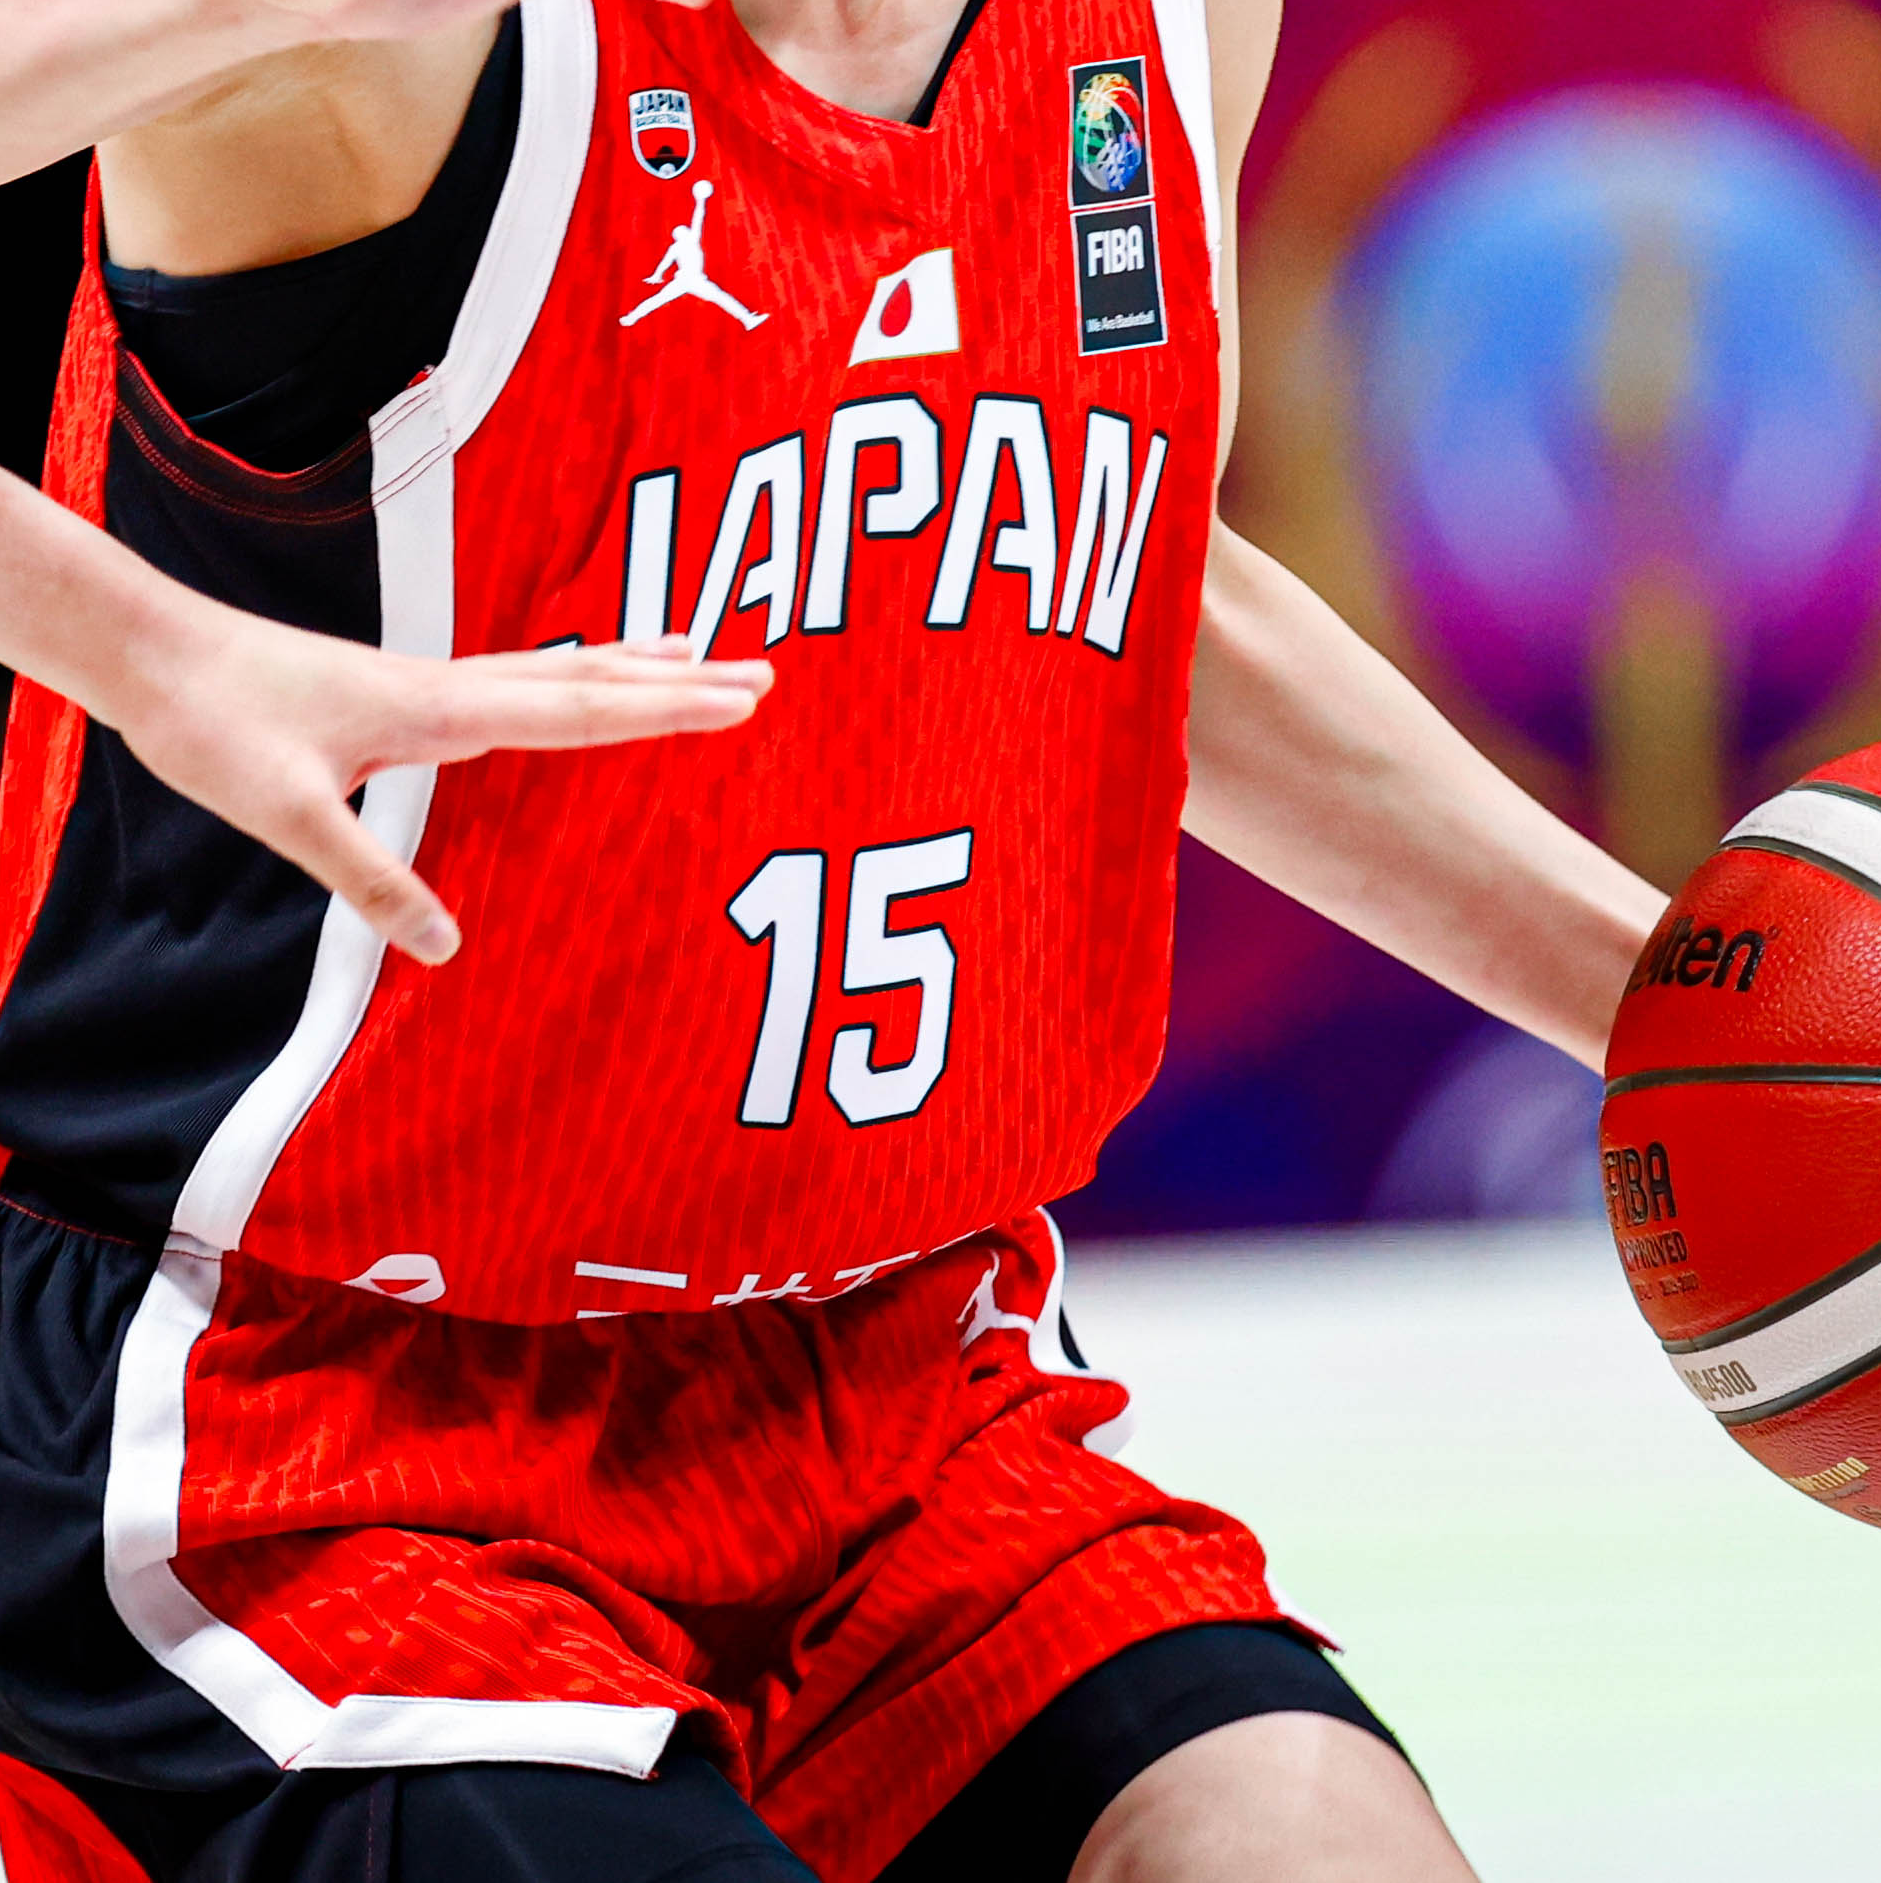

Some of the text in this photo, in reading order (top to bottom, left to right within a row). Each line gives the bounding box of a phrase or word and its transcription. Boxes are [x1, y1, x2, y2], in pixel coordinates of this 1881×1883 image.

[1087, 225, 1145, 278] FIBA
[536, 391, 1169, 660] JAPAN
[727, 826, 975, 1129] 15
[1602, 1141, 1678, 1229] FIBA
